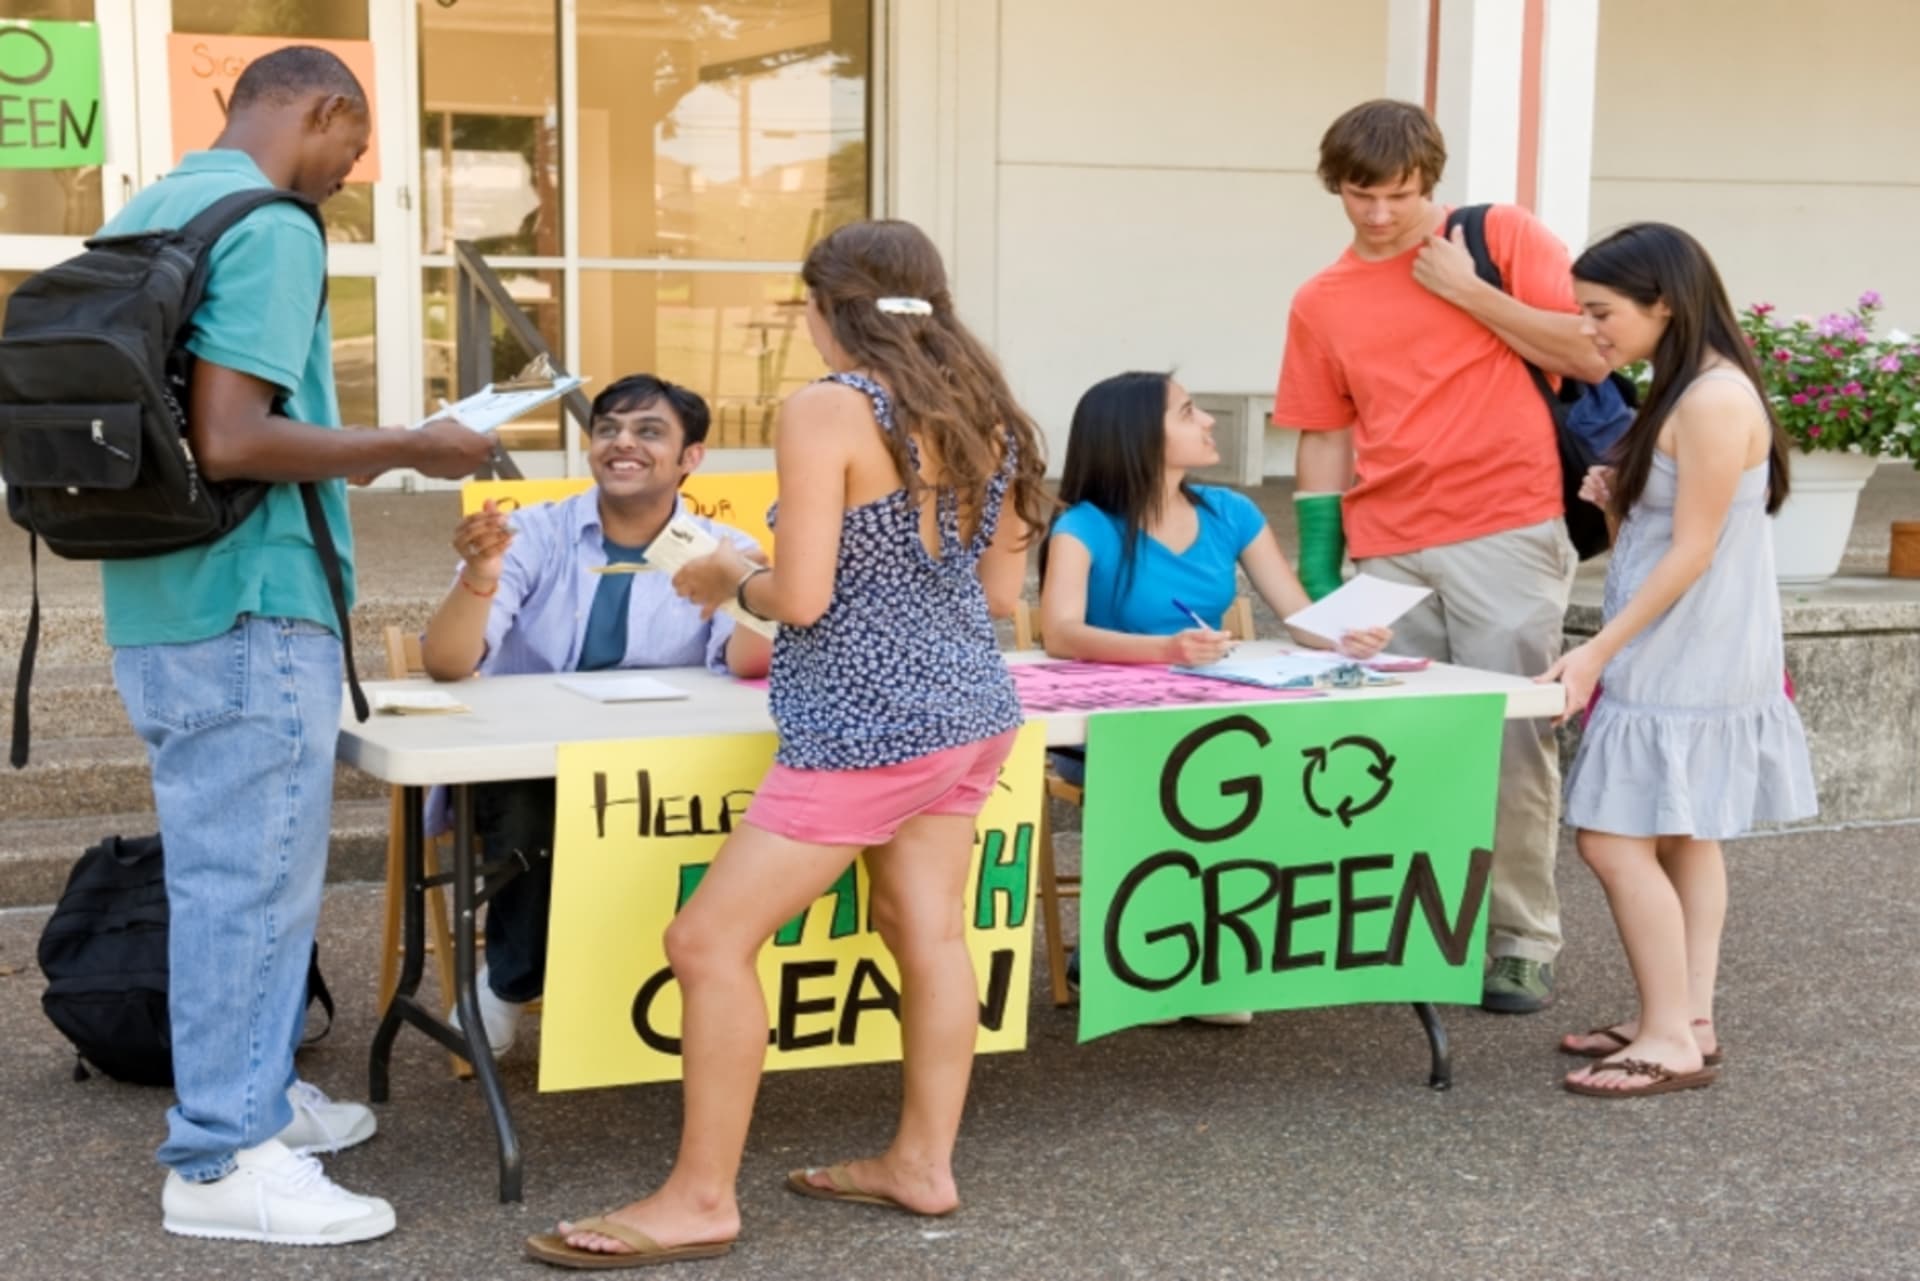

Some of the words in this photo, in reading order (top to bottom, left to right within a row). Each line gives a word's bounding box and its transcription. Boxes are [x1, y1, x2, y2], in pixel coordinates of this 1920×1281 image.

[590, 769, 756, 838] HELP
[1104, 848, 1494, 993] GREEN
[631, 949, 1015, 1056] CEA
